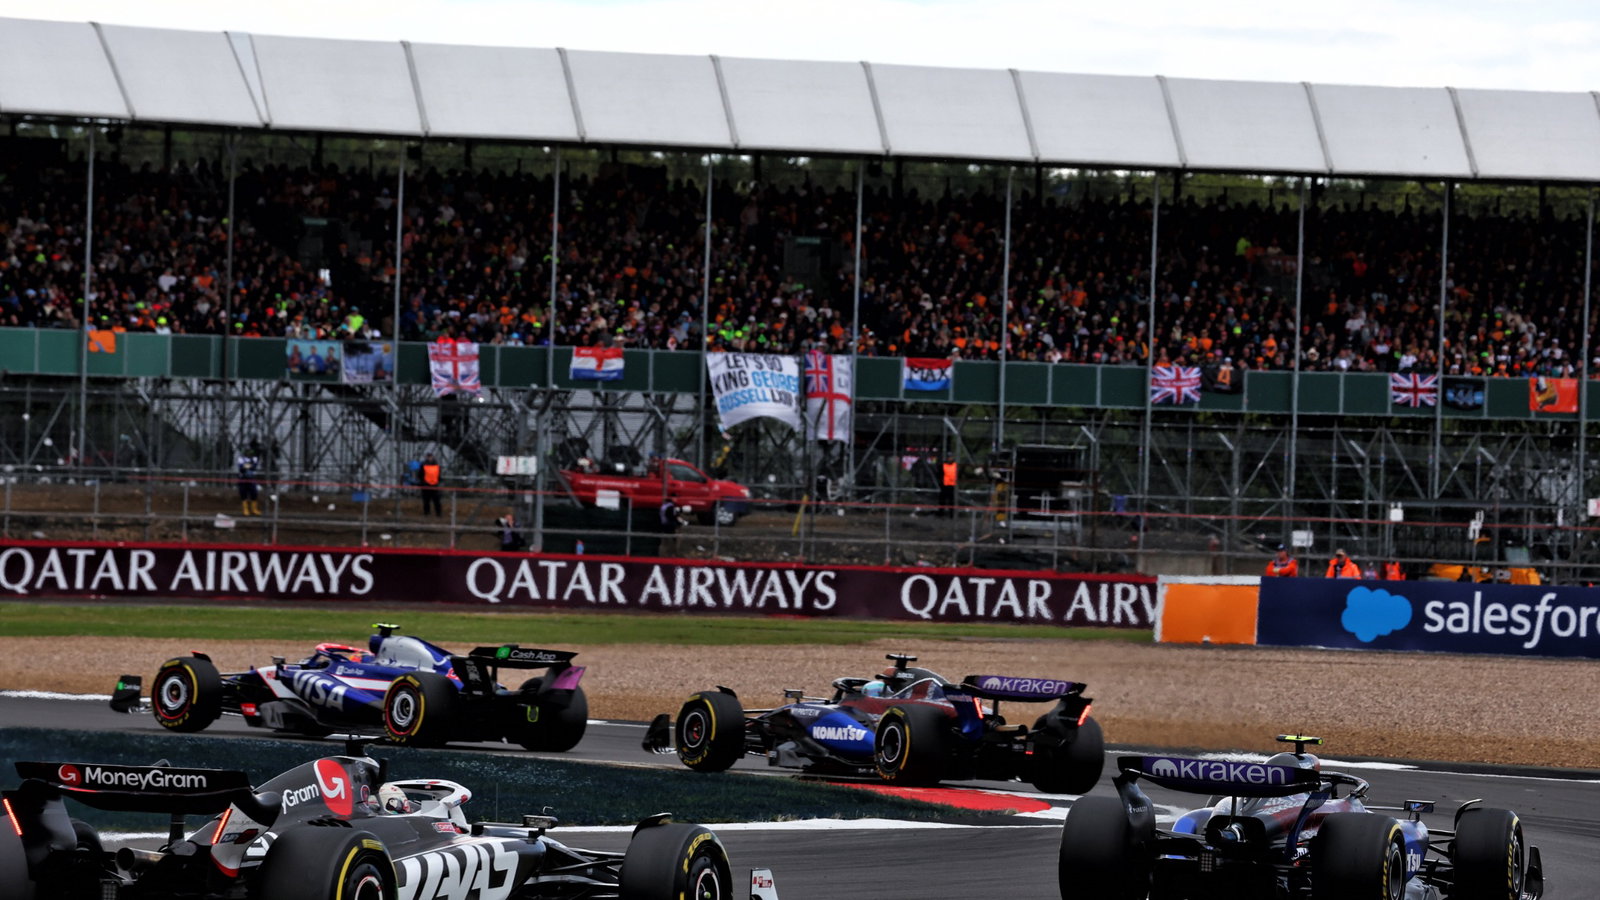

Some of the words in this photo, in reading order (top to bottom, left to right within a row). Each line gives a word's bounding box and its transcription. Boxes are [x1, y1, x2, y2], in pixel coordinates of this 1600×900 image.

[725, 354, 764, 370] LET'S
[714, 371, 749, 395] KING
[909, 366, 951, 383] MAX
[0, 548, 157, 594] QATAR
[170, 550, 374, 595] AIRWAYS
[466, 557, 627, 604] QATAR
[639, 564, 837, 610] AIRWAYS
[901, 574, 1054, 619] QATAR
[1423, 590, 1600, 649] salesfor
[510, 650, 535, 660] Cash
[536, 650, 557, 661] App
[293, 671, 347, 712] VISA
[1001, 677, 1067, 695] kraken
[812, 724, 868, 741] KOMATSU
[85, 767, 207, 790] MoneyGram
[1179, 759, 1286, 785] kraken
